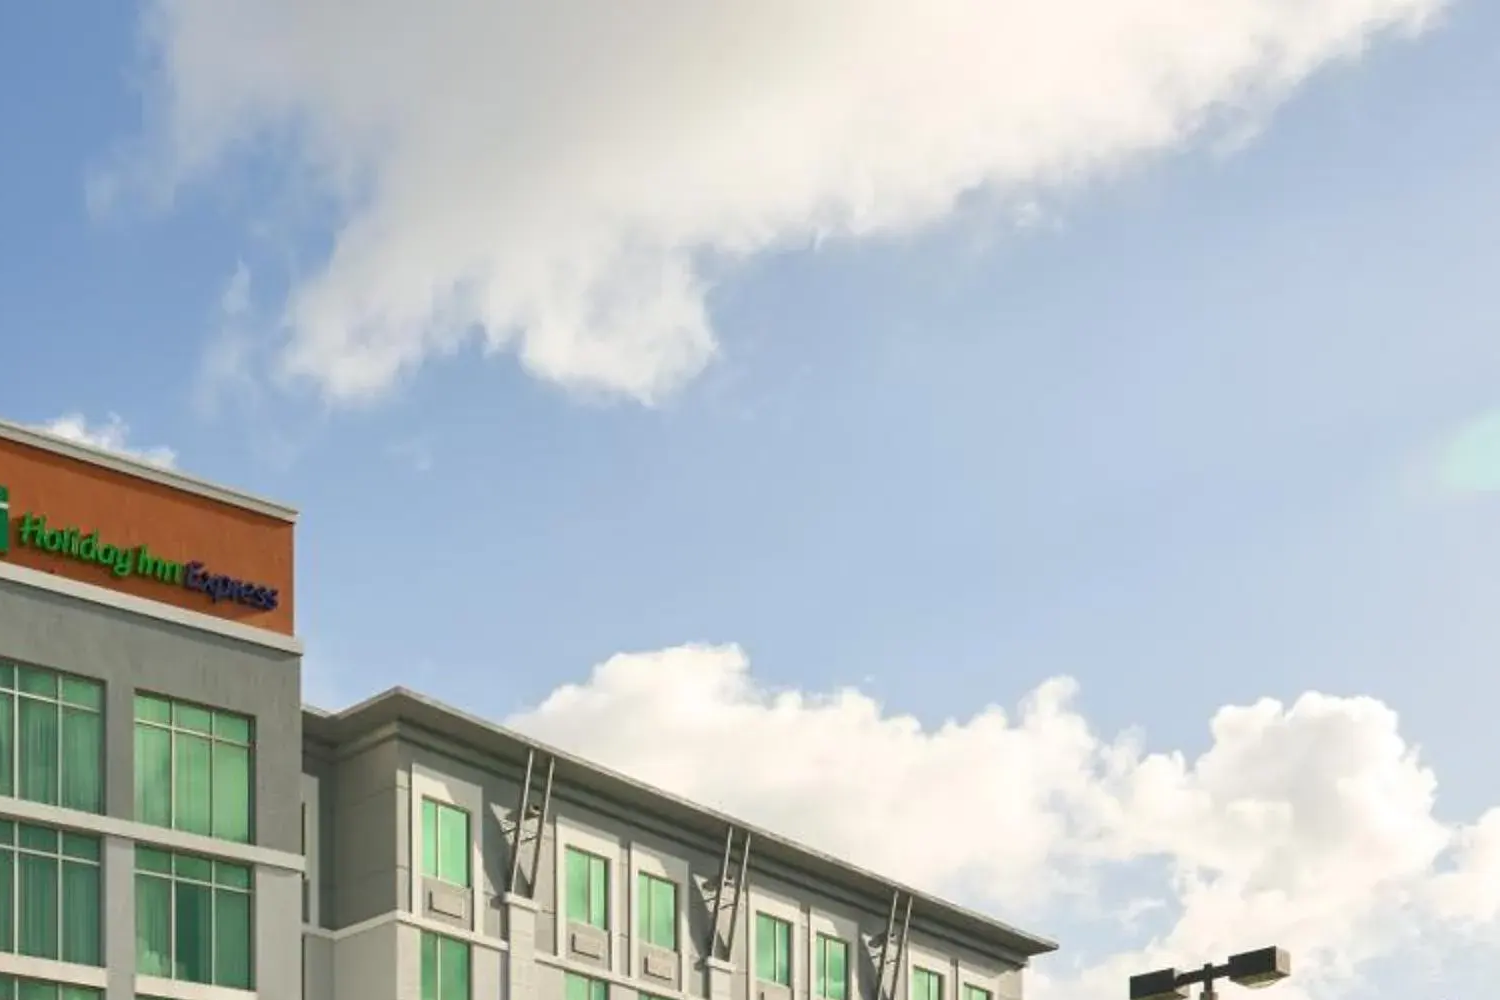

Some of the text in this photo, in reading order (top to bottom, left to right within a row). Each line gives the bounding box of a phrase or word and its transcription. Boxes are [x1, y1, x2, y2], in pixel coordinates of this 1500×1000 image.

[20, 510, 279, 610] Holiday Inn Express
